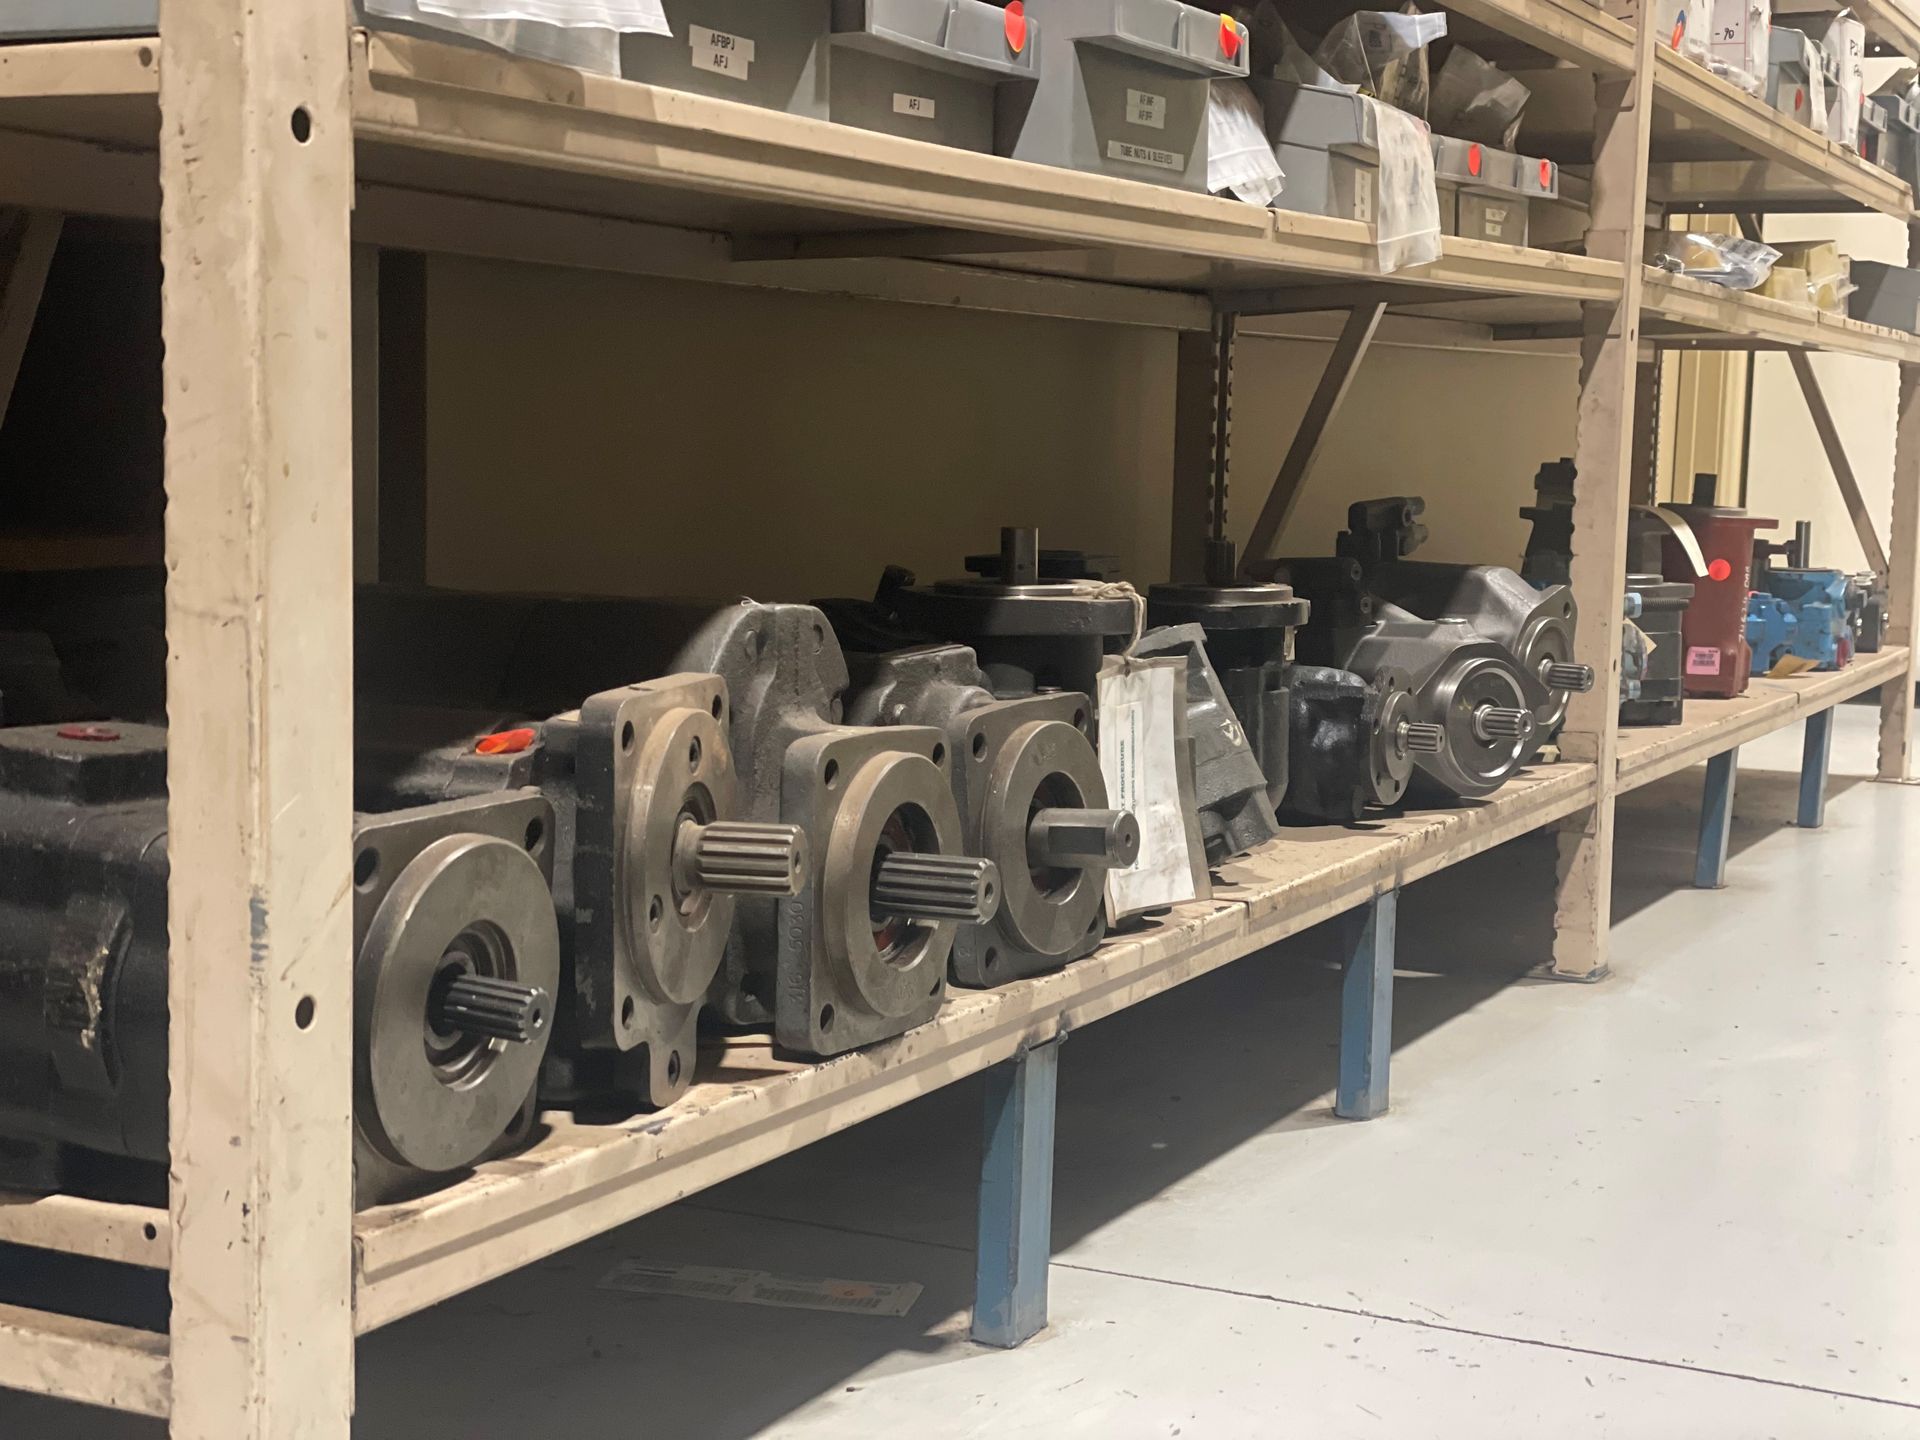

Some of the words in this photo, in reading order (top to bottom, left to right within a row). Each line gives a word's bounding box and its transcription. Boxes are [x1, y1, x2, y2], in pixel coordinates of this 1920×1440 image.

[710, 32, 736, 51] AFBPJ
[713, 53, 729, 69] AFJ
[909, 98, 921, 111] AFJ
